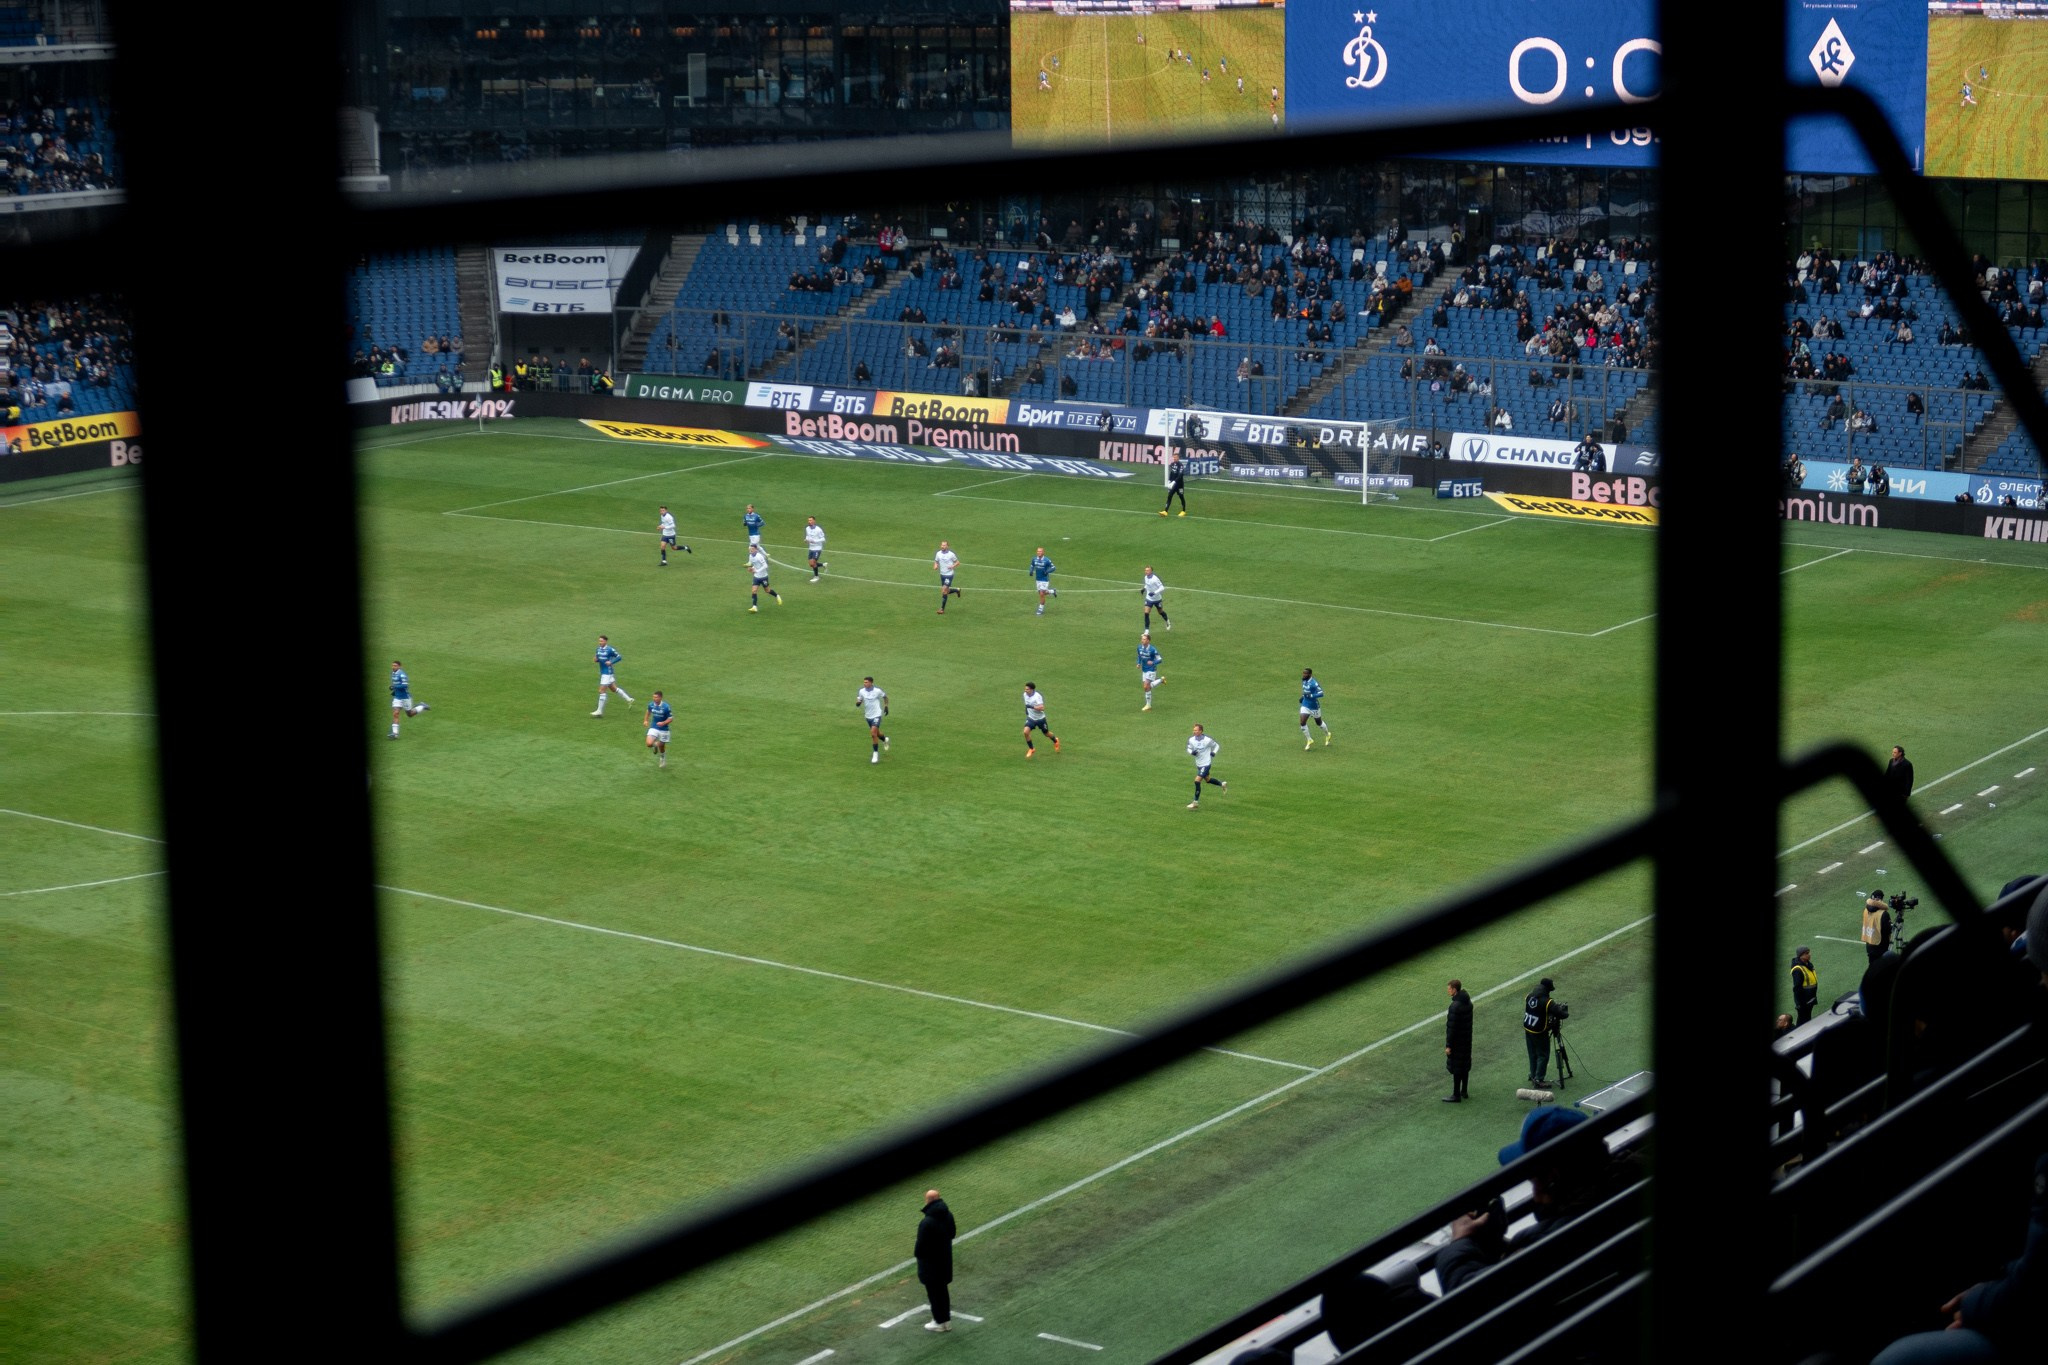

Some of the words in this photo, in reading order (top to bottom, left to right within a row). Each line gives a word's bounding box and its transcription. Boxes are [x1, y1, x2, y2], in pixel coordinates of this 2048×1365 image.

[503, 253, 605, 264] BetBoom
[532, 302, 585, 313] ВТБ
[639, 385, 694, 400] DIGMA
[701, 388, 733, 402] PRO
[771, 391, 801, 409] ВТБ
[833, 396, 866, 413] ВТБ
[890, 397, 989, 423] BetBoom
[1017, 404, 1064, 427] Брит
[1067, 413, 1137, 428] ПРЕМУМ
[27, 421, 119, 447] BetBoom
[599, 424, 728, 444] BetBoom
[785, 411, 898, 443] BetBoom
[907, 419, 1020, 453] Premium
[1174, 419, 1210, 438] ВБ
[1247, 423, 1284, 445] ВТБ
[792, 439, 856, 457] ВТБ
[1319, 427, 1428, 452] DREAME
[863, 445, 927, 463] ВТБ
[966, 452, 1033, 470] ВТБ
[1496, 447, 1582, 467] CHANG
[1041, 458, 1109, 477] ВТБ
[1189, 460, 1219, 475] ВТБ
[1240, 468, 1255, 476] ВТБ
[1264, 468, 1280, 476] ВТБ
[1344, 477, 1360, 485] ВТБ
[1453, 482, 1483, 498] ВТБ
[1999, 482, 2041, 493] ЭЛЕКТ
[1571, 472, 1661, 509] BetBo
[1505, 497, 1653, 523] BetBoom
